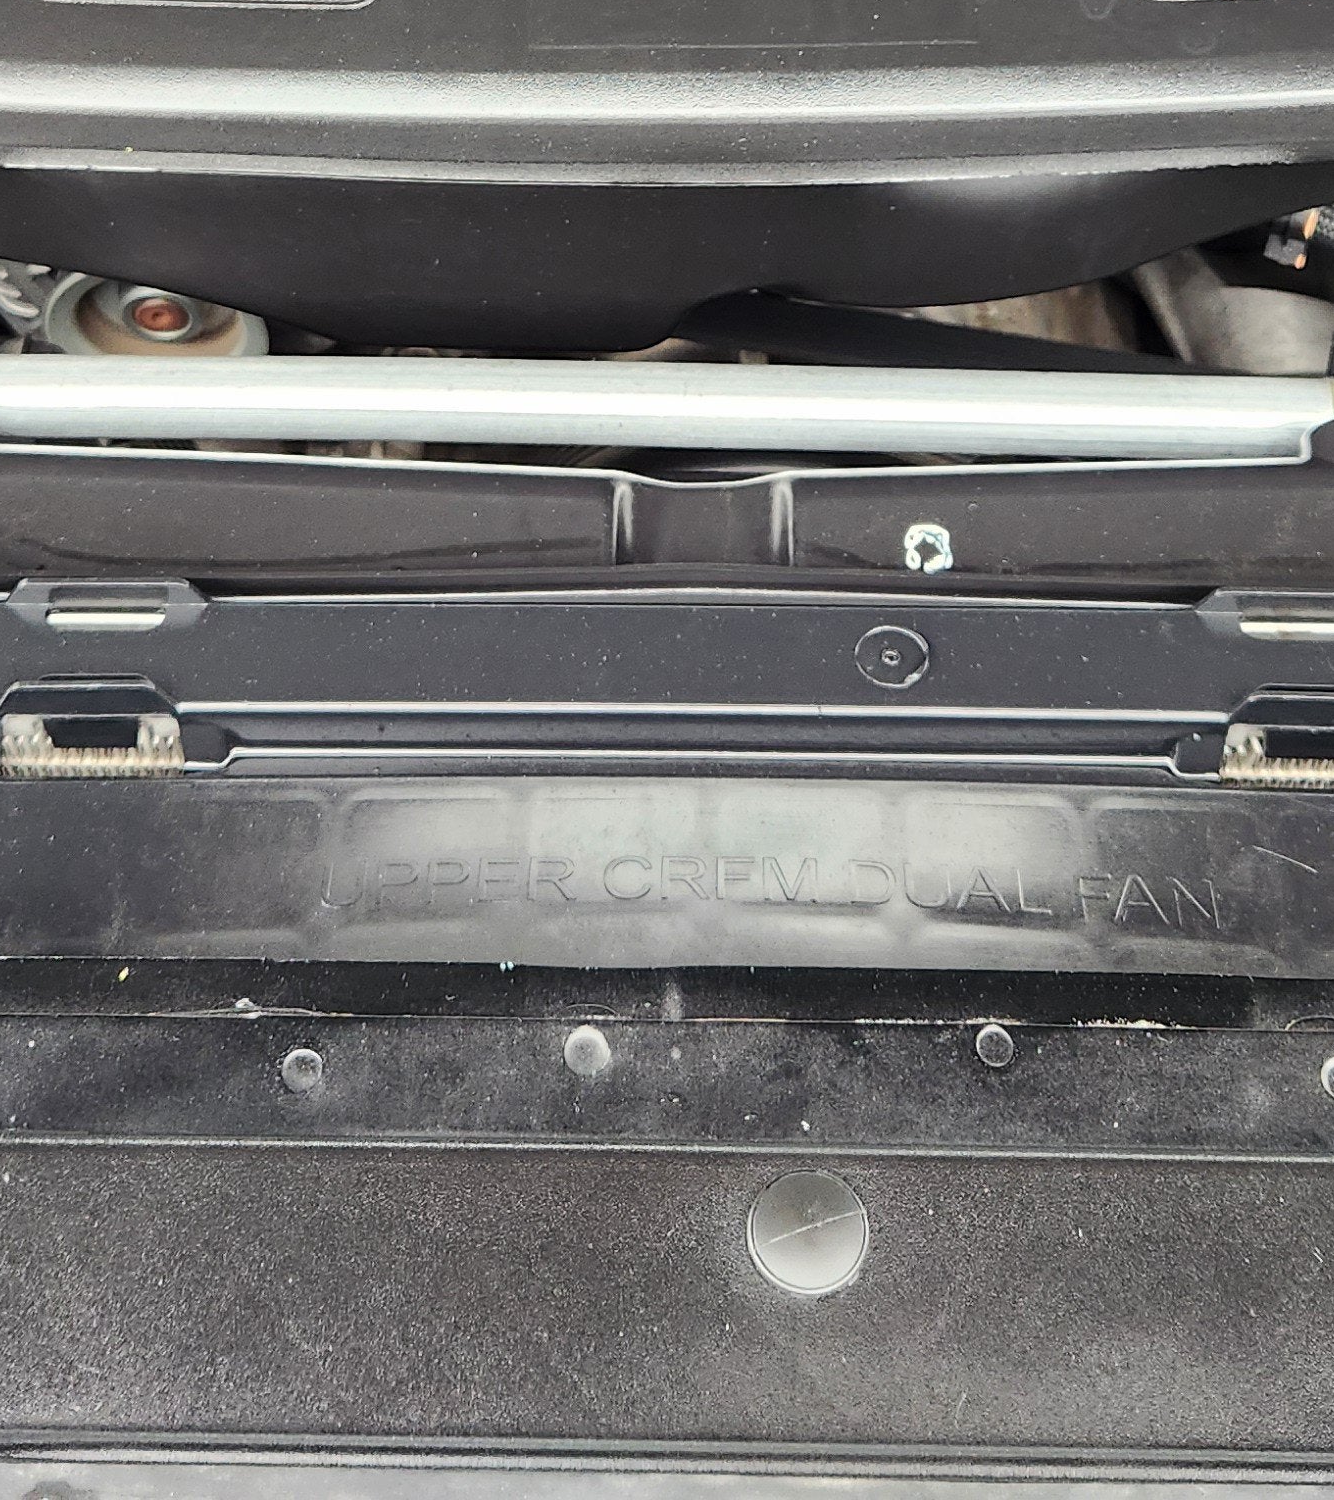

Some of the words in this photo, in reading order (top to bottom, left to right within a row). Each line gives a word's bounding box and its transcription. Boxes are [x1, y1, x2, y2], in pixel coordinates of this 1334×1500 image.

[322, 855, 577, 907] UPPER
[602, 854, 819, 902] CRFM
[848, 858, 1053, 916] DUAL
[1078, 873, 1221, 930] FAN
